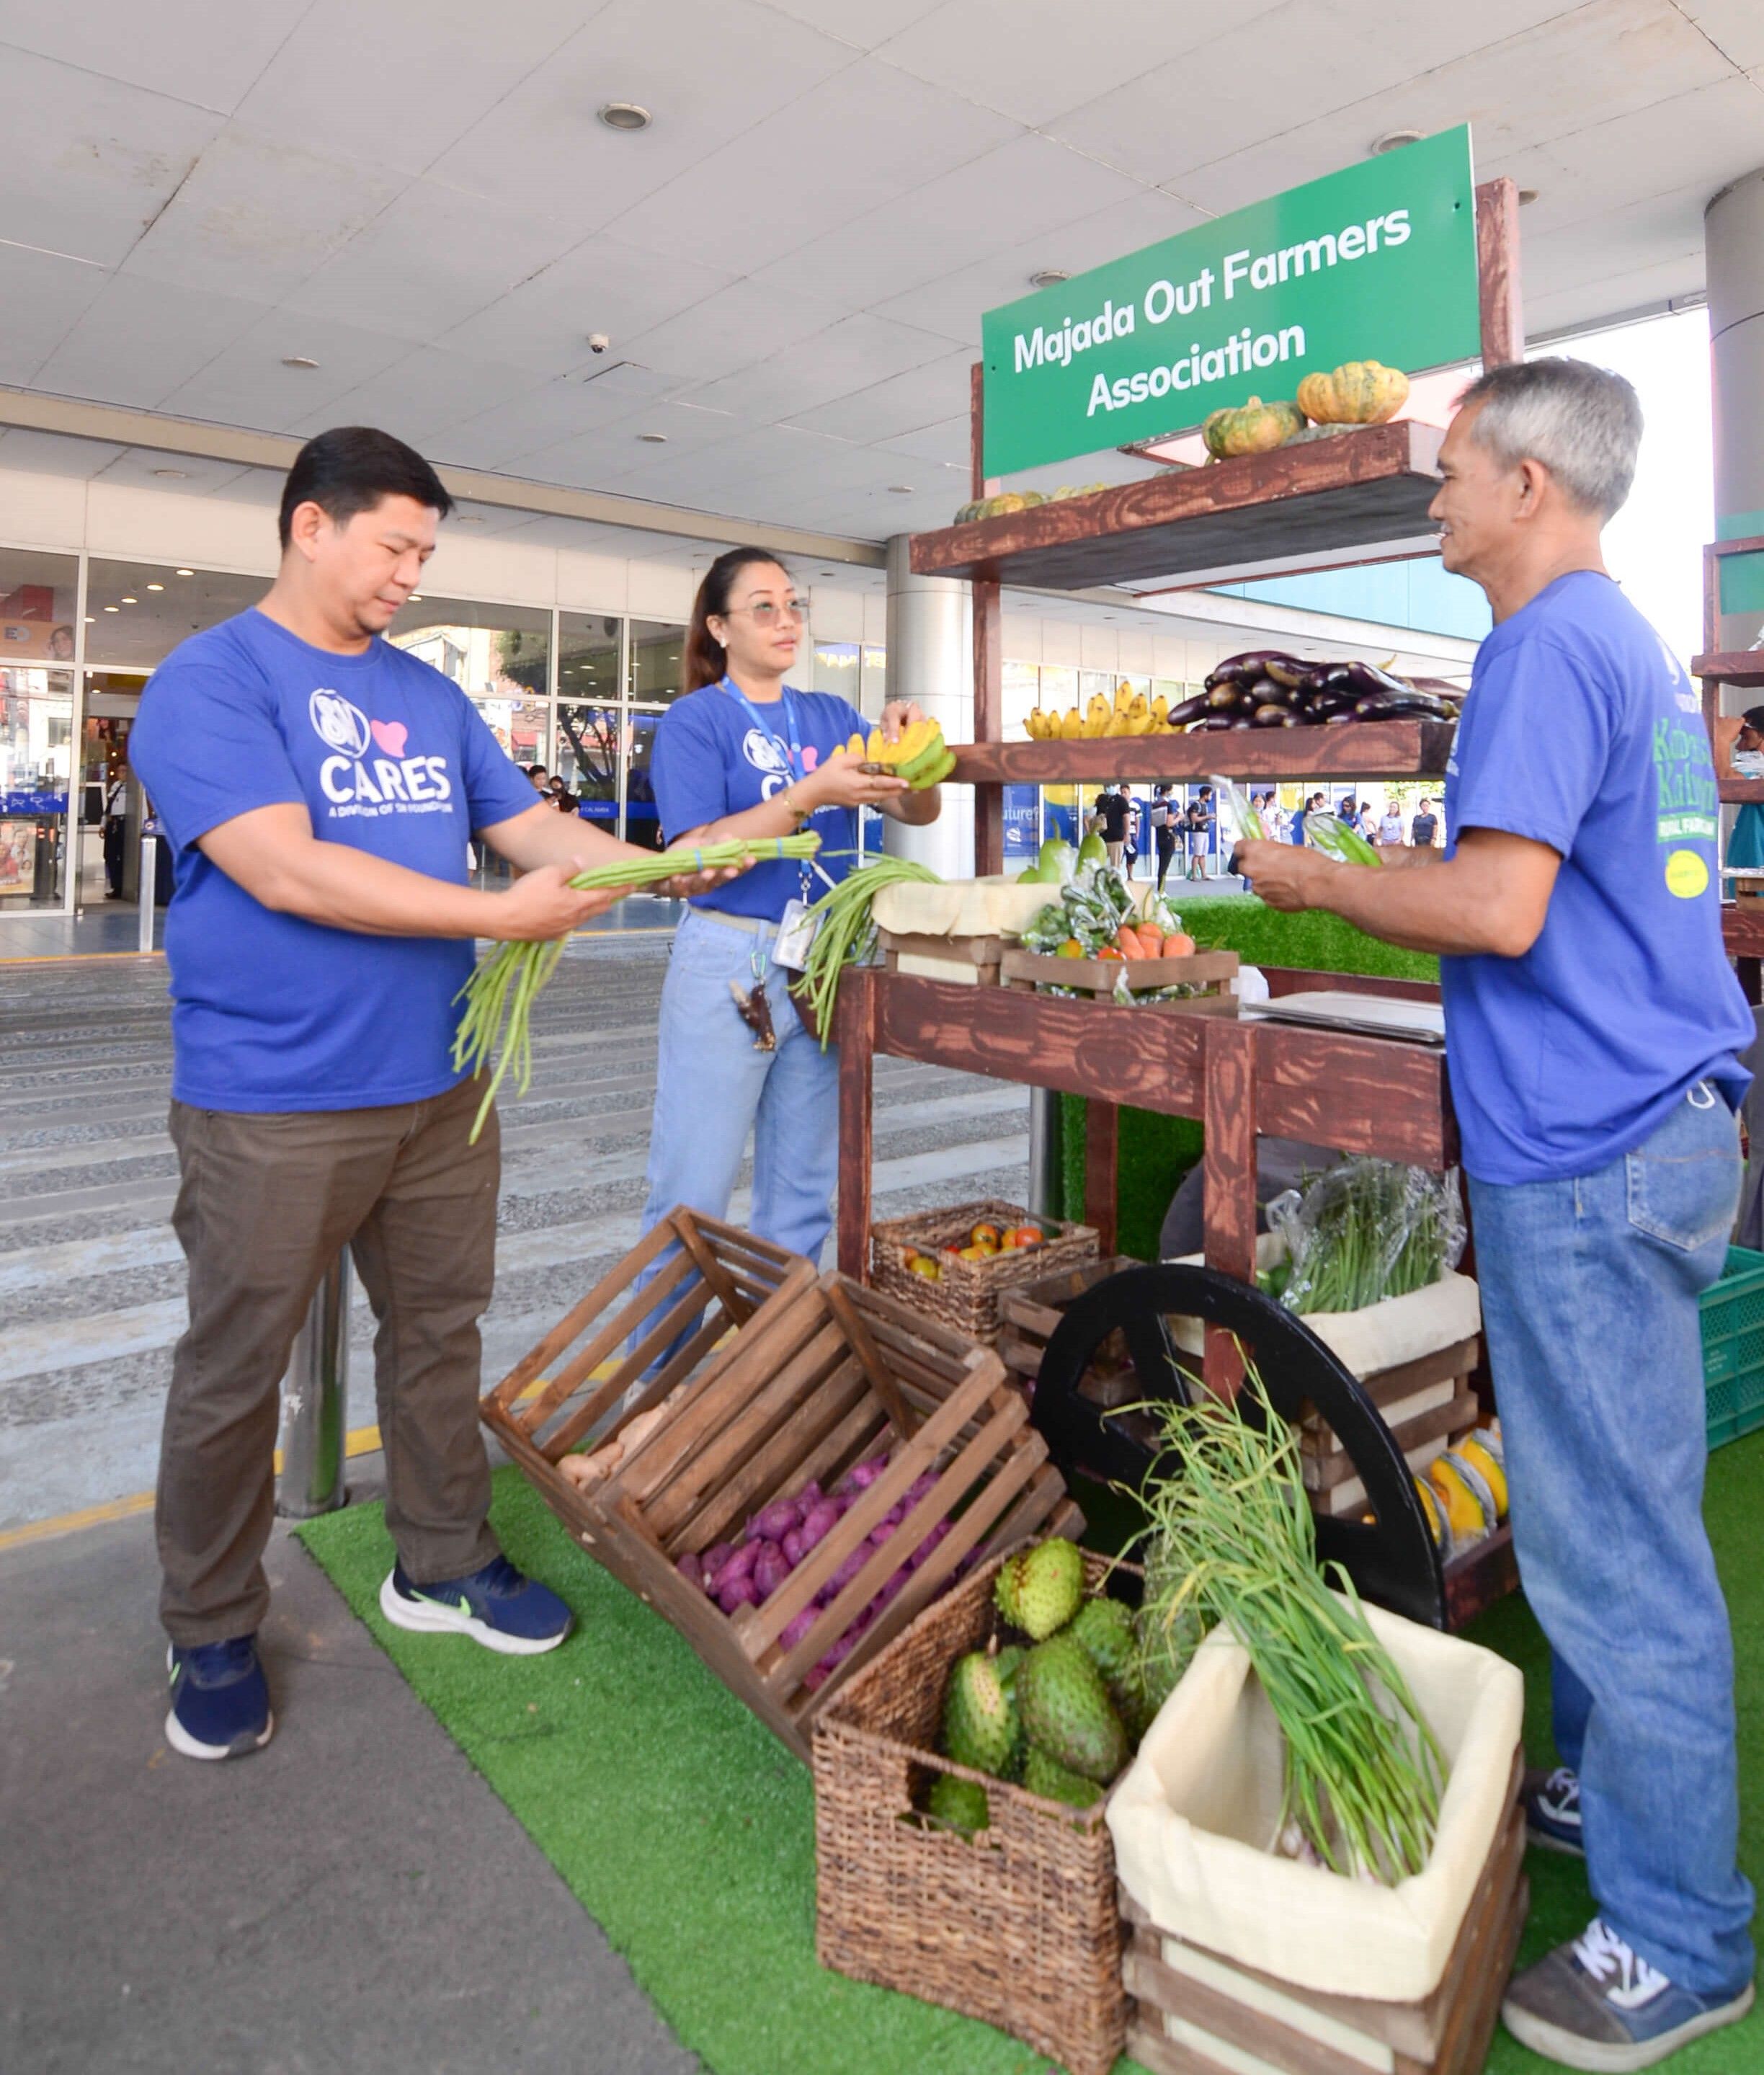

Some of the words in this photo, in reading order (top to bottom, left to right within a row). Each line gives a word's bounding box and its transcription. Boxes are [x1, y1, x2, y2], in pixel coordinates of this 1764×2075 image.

[1014, 300, 1135, 373] Majada
[1144, 268, 1215, 324] Out
[1224, 209, 1412, 301] Farmers
[1086, 324, 1306, 417] Association
[320, 755, 451, 804] CARES
